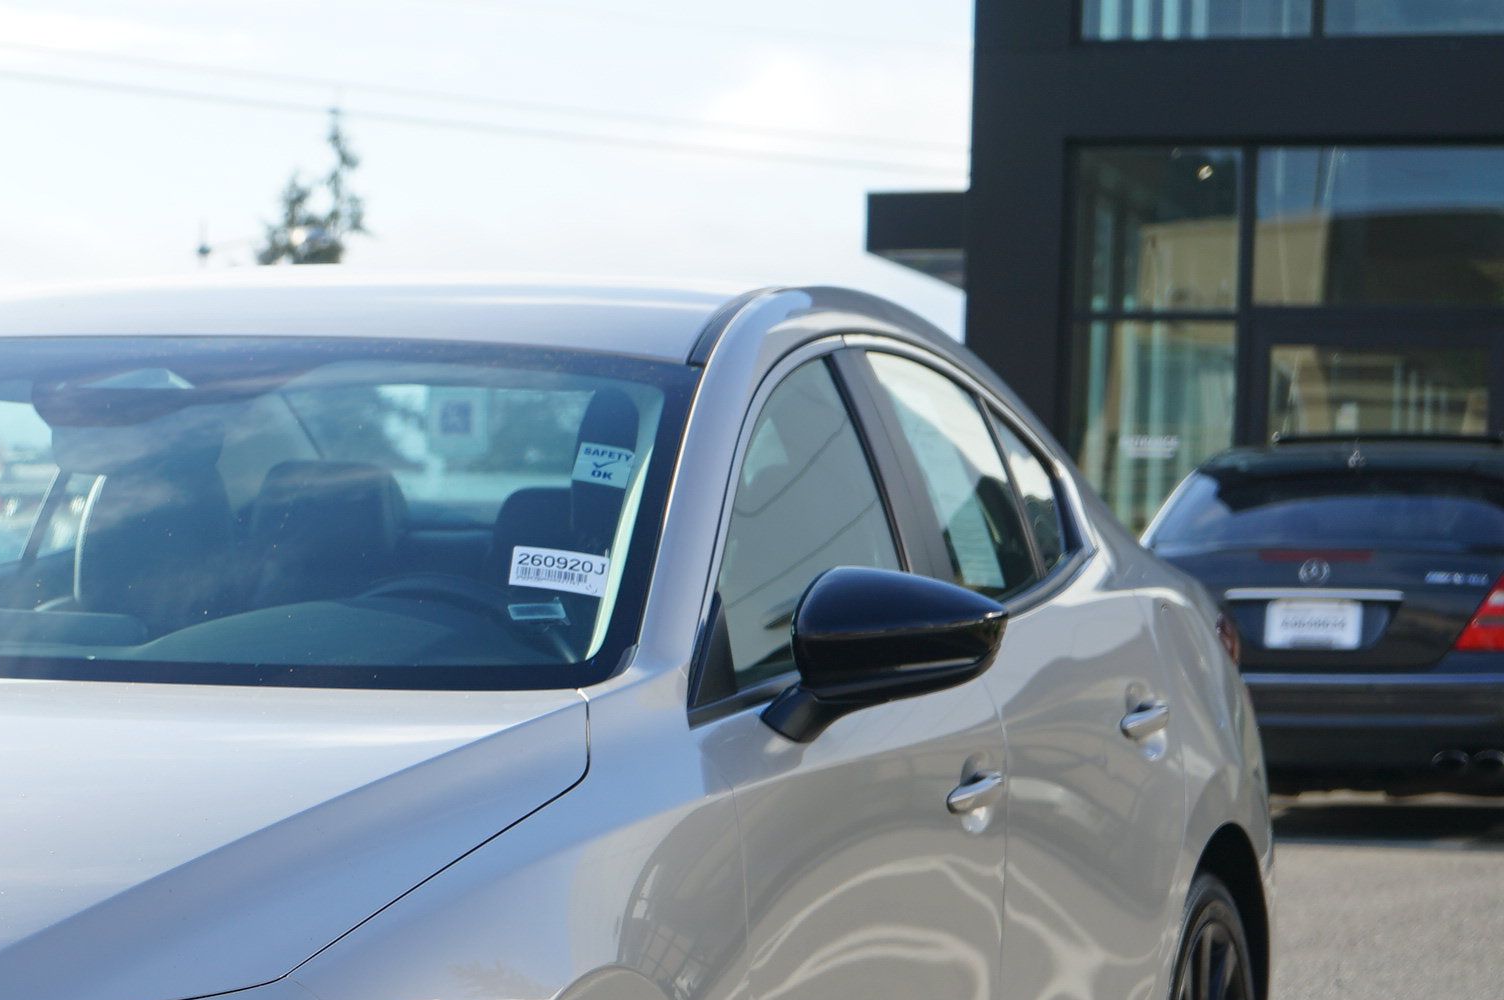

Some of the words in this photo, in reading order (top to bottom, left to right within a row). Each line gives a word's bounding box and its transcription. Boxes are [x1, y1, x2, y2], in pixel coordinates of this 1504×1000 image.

[584, 448, 633, 461] SAFETY
[591, 470, 613, 480] OK
[518, 553, 607, 576] 260920J
